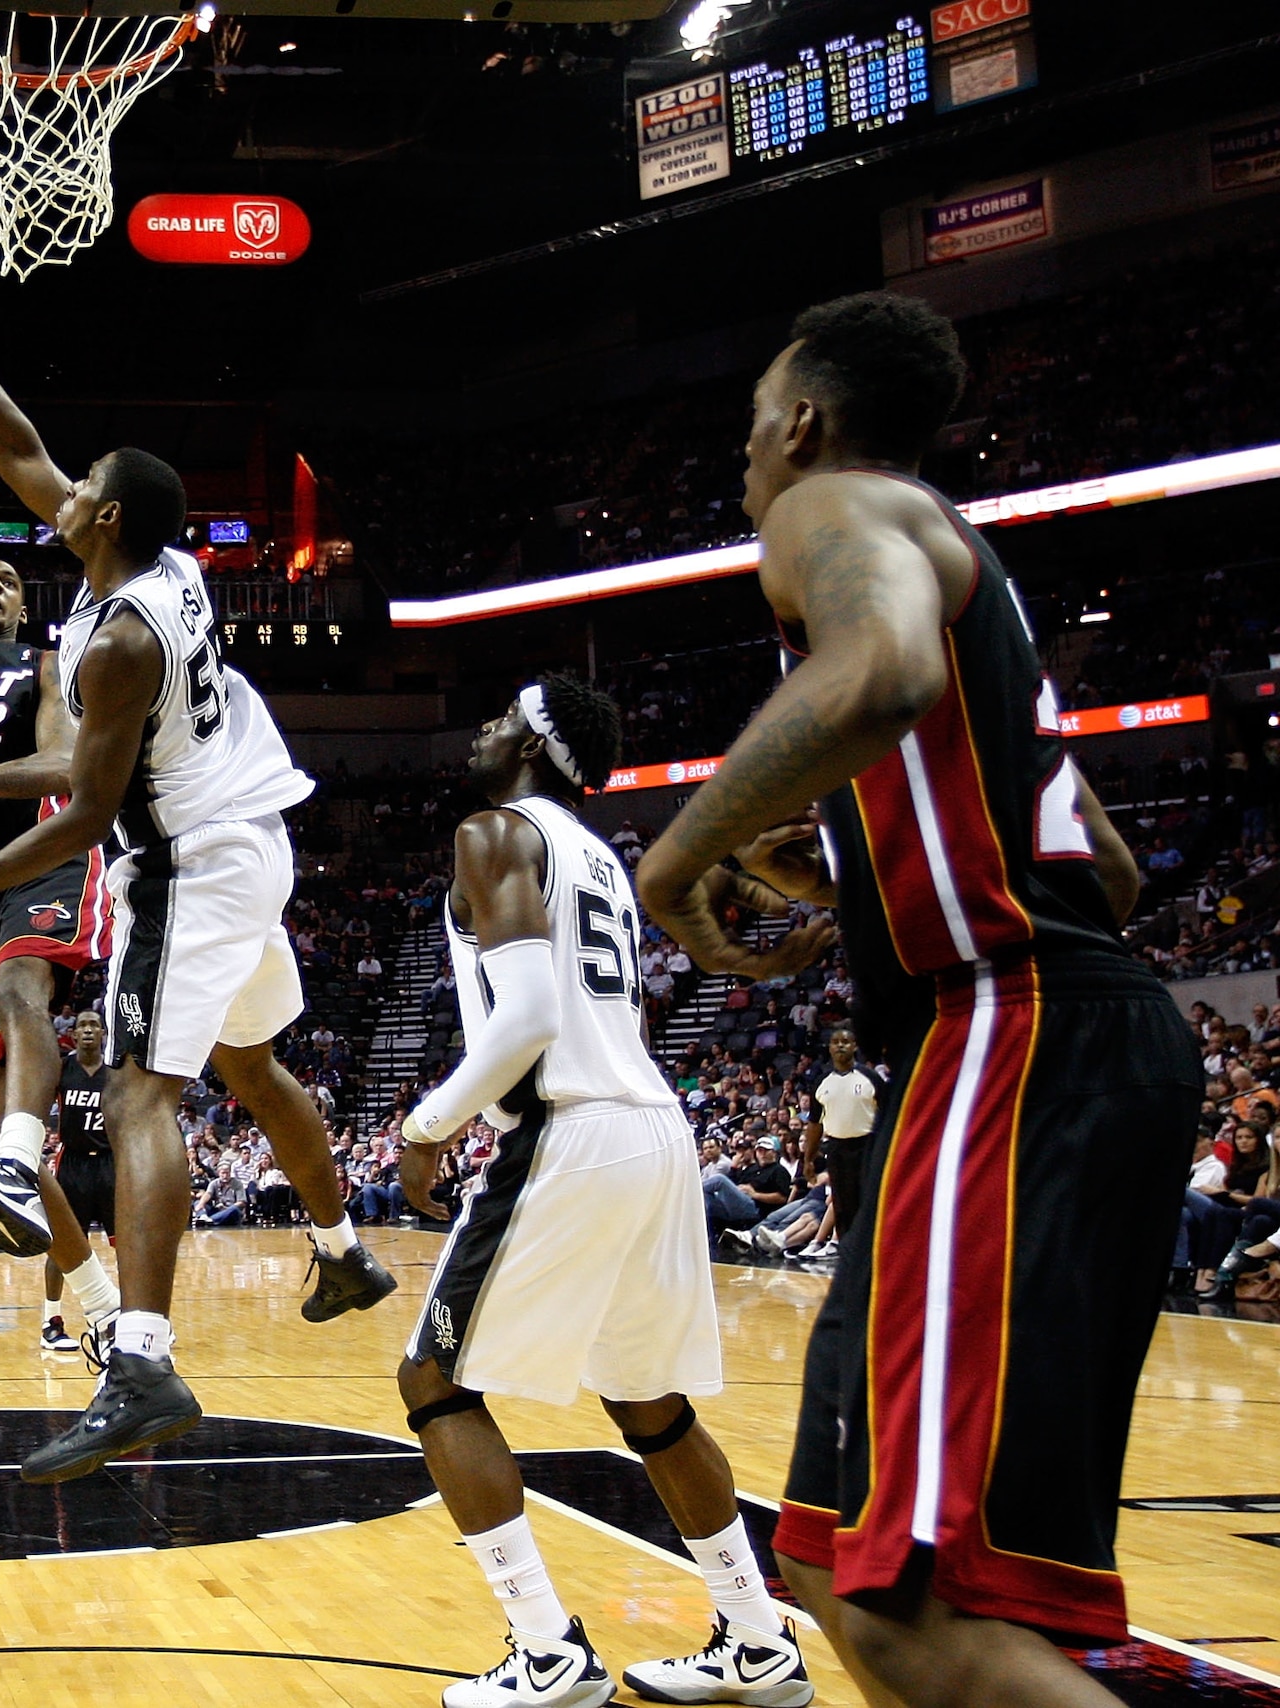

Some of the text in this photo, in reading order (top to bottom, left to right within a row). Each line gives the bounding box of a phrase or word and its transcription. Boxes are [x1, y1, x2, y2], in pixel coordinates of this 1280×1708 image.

[896, 16, 913, 30] 63
[825, 34, 855, 53] HEAT
[886, 44, 903, 56] AS
[906, 37, 924, 50] RB
[799, 49, 814, 61] 72
[730, 63, 768, 83] SPURS
[786, 76, 801, 87] AS
[869, 70, 884, 83] 00
[888, 64, 904, 76] 01
[889, 75, 904, 87] 01
[645, 80, 716, 117] 1200
[788, 96, 804, 107] 00
[890, 86, 906, 99] 00
[770, 112, 785, 124] 00
[789, 106, 804, 118] 00
[808, 101, 822, 112] 01
[851, 109, 868, 121] 00
[870, 104, 885, 115] 01
[890, 97, 907, 110] 00
[911, 91, 927, 104] 00
[646, 108, 718, 142] WOAI
[753, 129, 768, 140] 00
[771, 123, 785, 135] 01
[790, 117, 805, 129] 00
[809, 111, 824, 123] 00
[858, 111, 903, 133] FLS 04
[753, 139, 769, 151] 00
[772, 133, 787, 145] 00
[790, 128, 806, 140] 00
[809, 122, 825, 134] 00
[641, 148, 673, 164] SPURS
[660, 150, 708, 172] COVERAGE
[760, 141, 802, 162] FLS 01
[652, 176, 665, 188] ON
[938, 192, 1028, 226] RJ'S CORNER
[147, 218, 226, 232] GRAB LIFE
[966, 217, 1042, 247] TOSTITOS
[228, 250, 287, 260] DODGE
[224, 625, 237, 635] ST
[257, 625, 272, 635] AS
[293, 625, 307, 635] RB
[329, 625, 342, 635] BL
[227, 635, 234, 645] 3
[260, 635, 271, 645] 11
[294, 635, 307, 645] 39
[333, 635, 339, 645] 1
[1144, 703, 1181, 721] at&t
[609, 762, 717, 787] at&t at&t
[573, 884, 641, 1009] 51
[65, 1090, 101, 1107] HEA
[84, 1111, 105, 1131] 12
